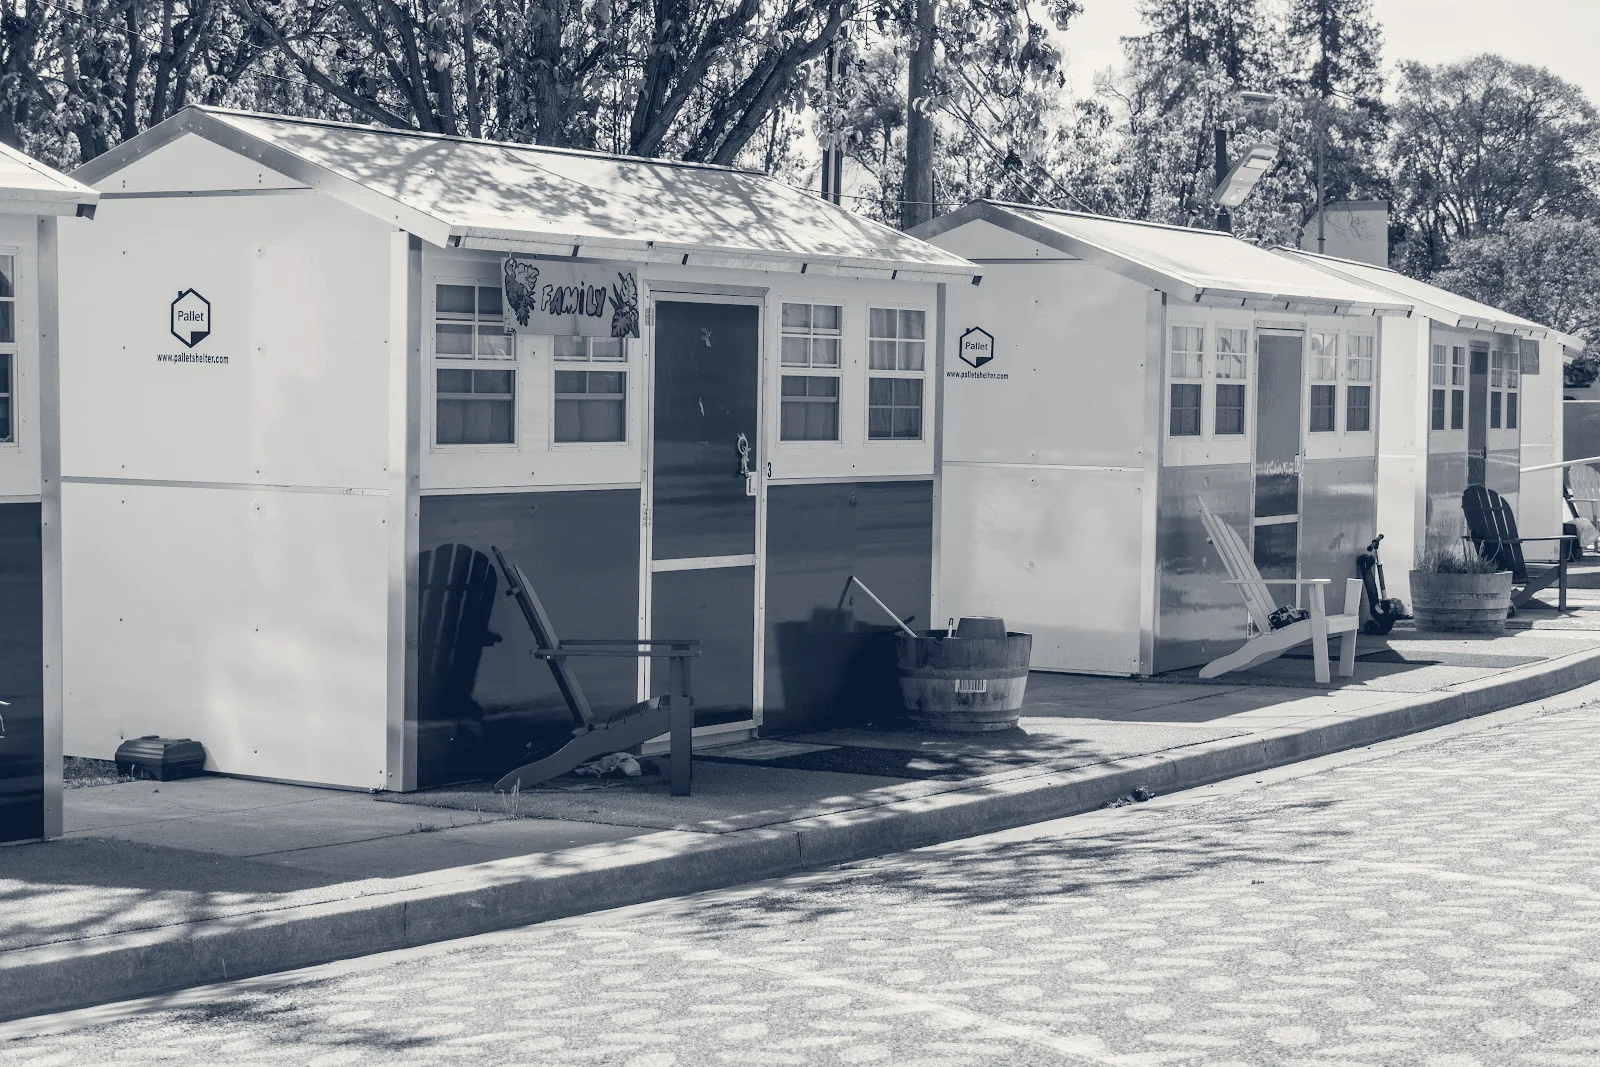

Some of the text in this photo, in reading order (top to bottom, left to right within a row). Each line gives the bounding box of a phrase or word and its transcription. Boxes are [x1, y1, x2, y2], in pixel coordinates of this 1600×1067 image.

[178, 311, 204, 321] Pallet
[965, 342, 988, 350] Pallet
[157, 353, 229, 364] www.palletshelter.com
[946, 371, 1009, 380] www.palletshelter.com
[767, 461, 772, 478] 3
